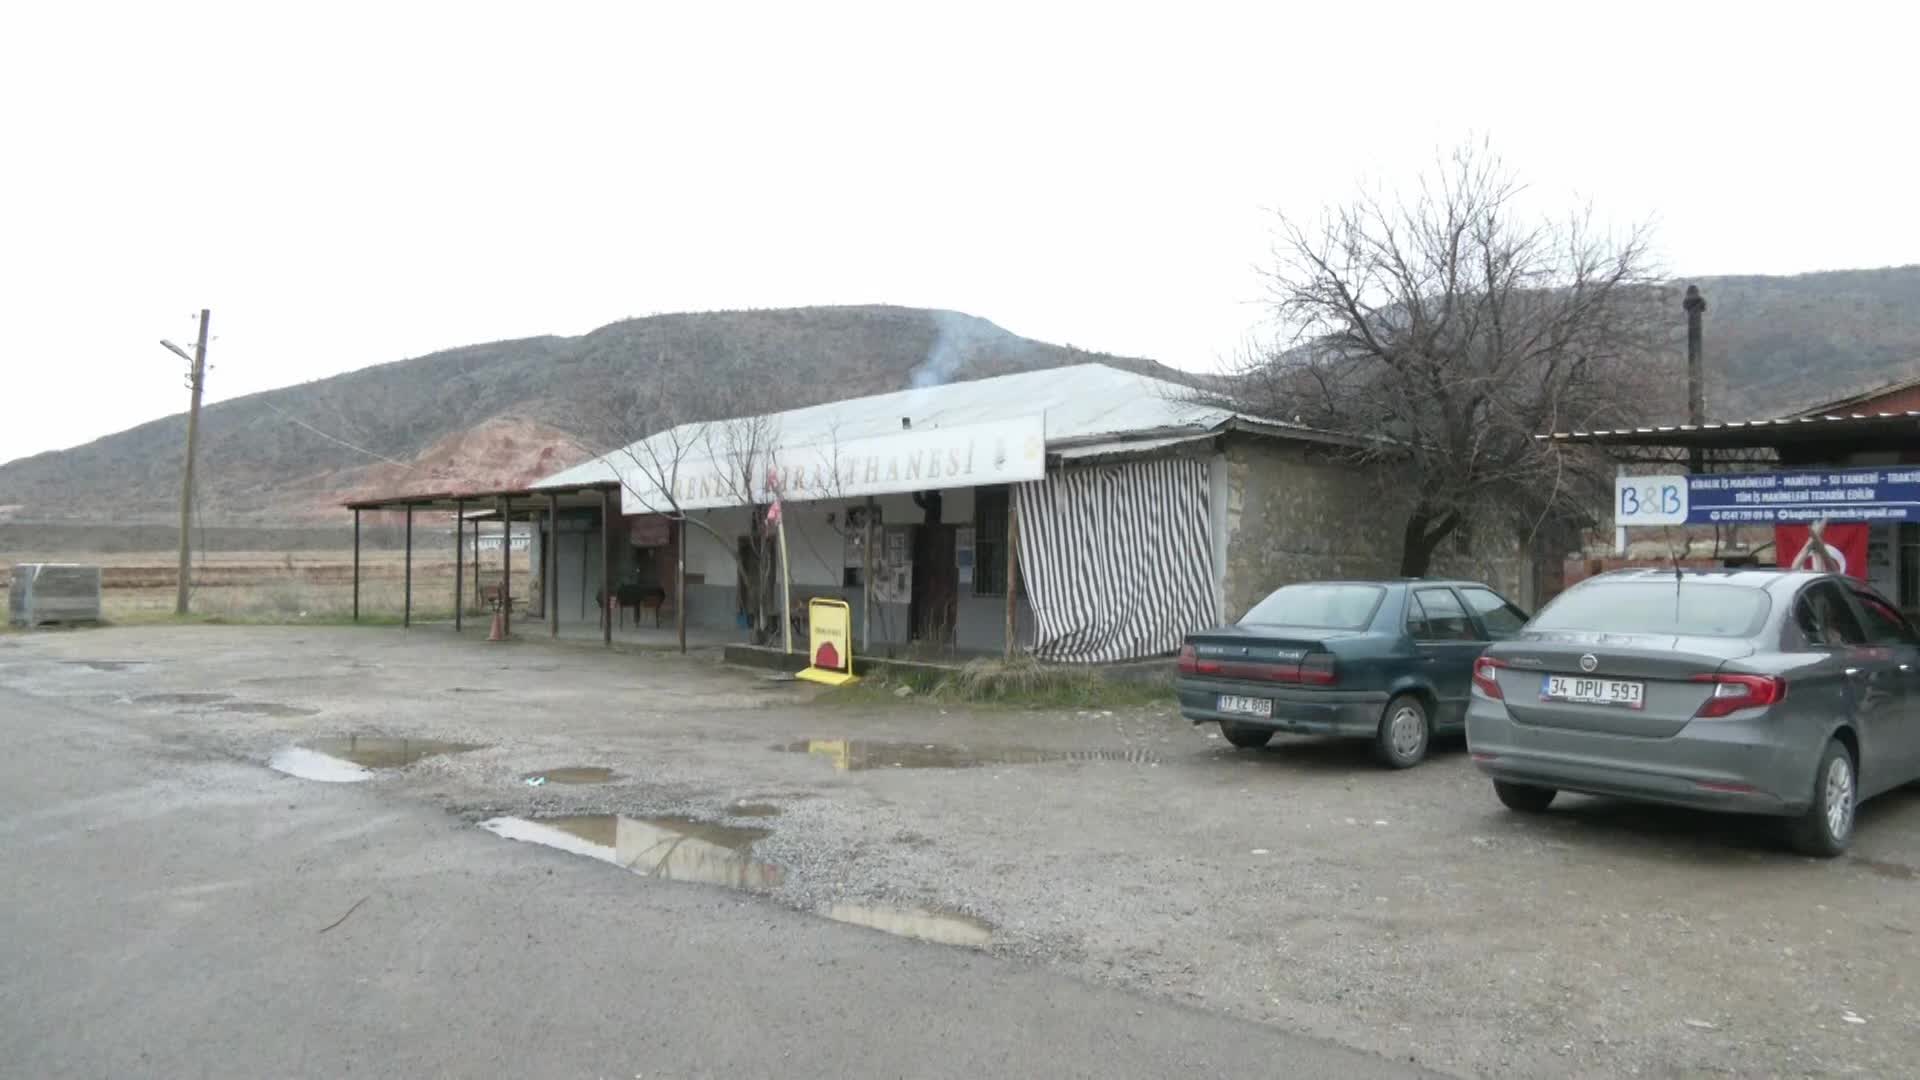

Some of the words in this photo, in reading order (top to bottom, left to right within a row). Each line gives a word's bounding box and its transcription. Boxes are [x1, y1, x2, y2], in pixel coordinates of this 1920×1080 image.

[1621, 485, 1681, 515] B&B
[1551, 679, 1568, 694] 34
[1575, 681, 1603, 697] DPU
[1611, 683, 1640, 700] 593
